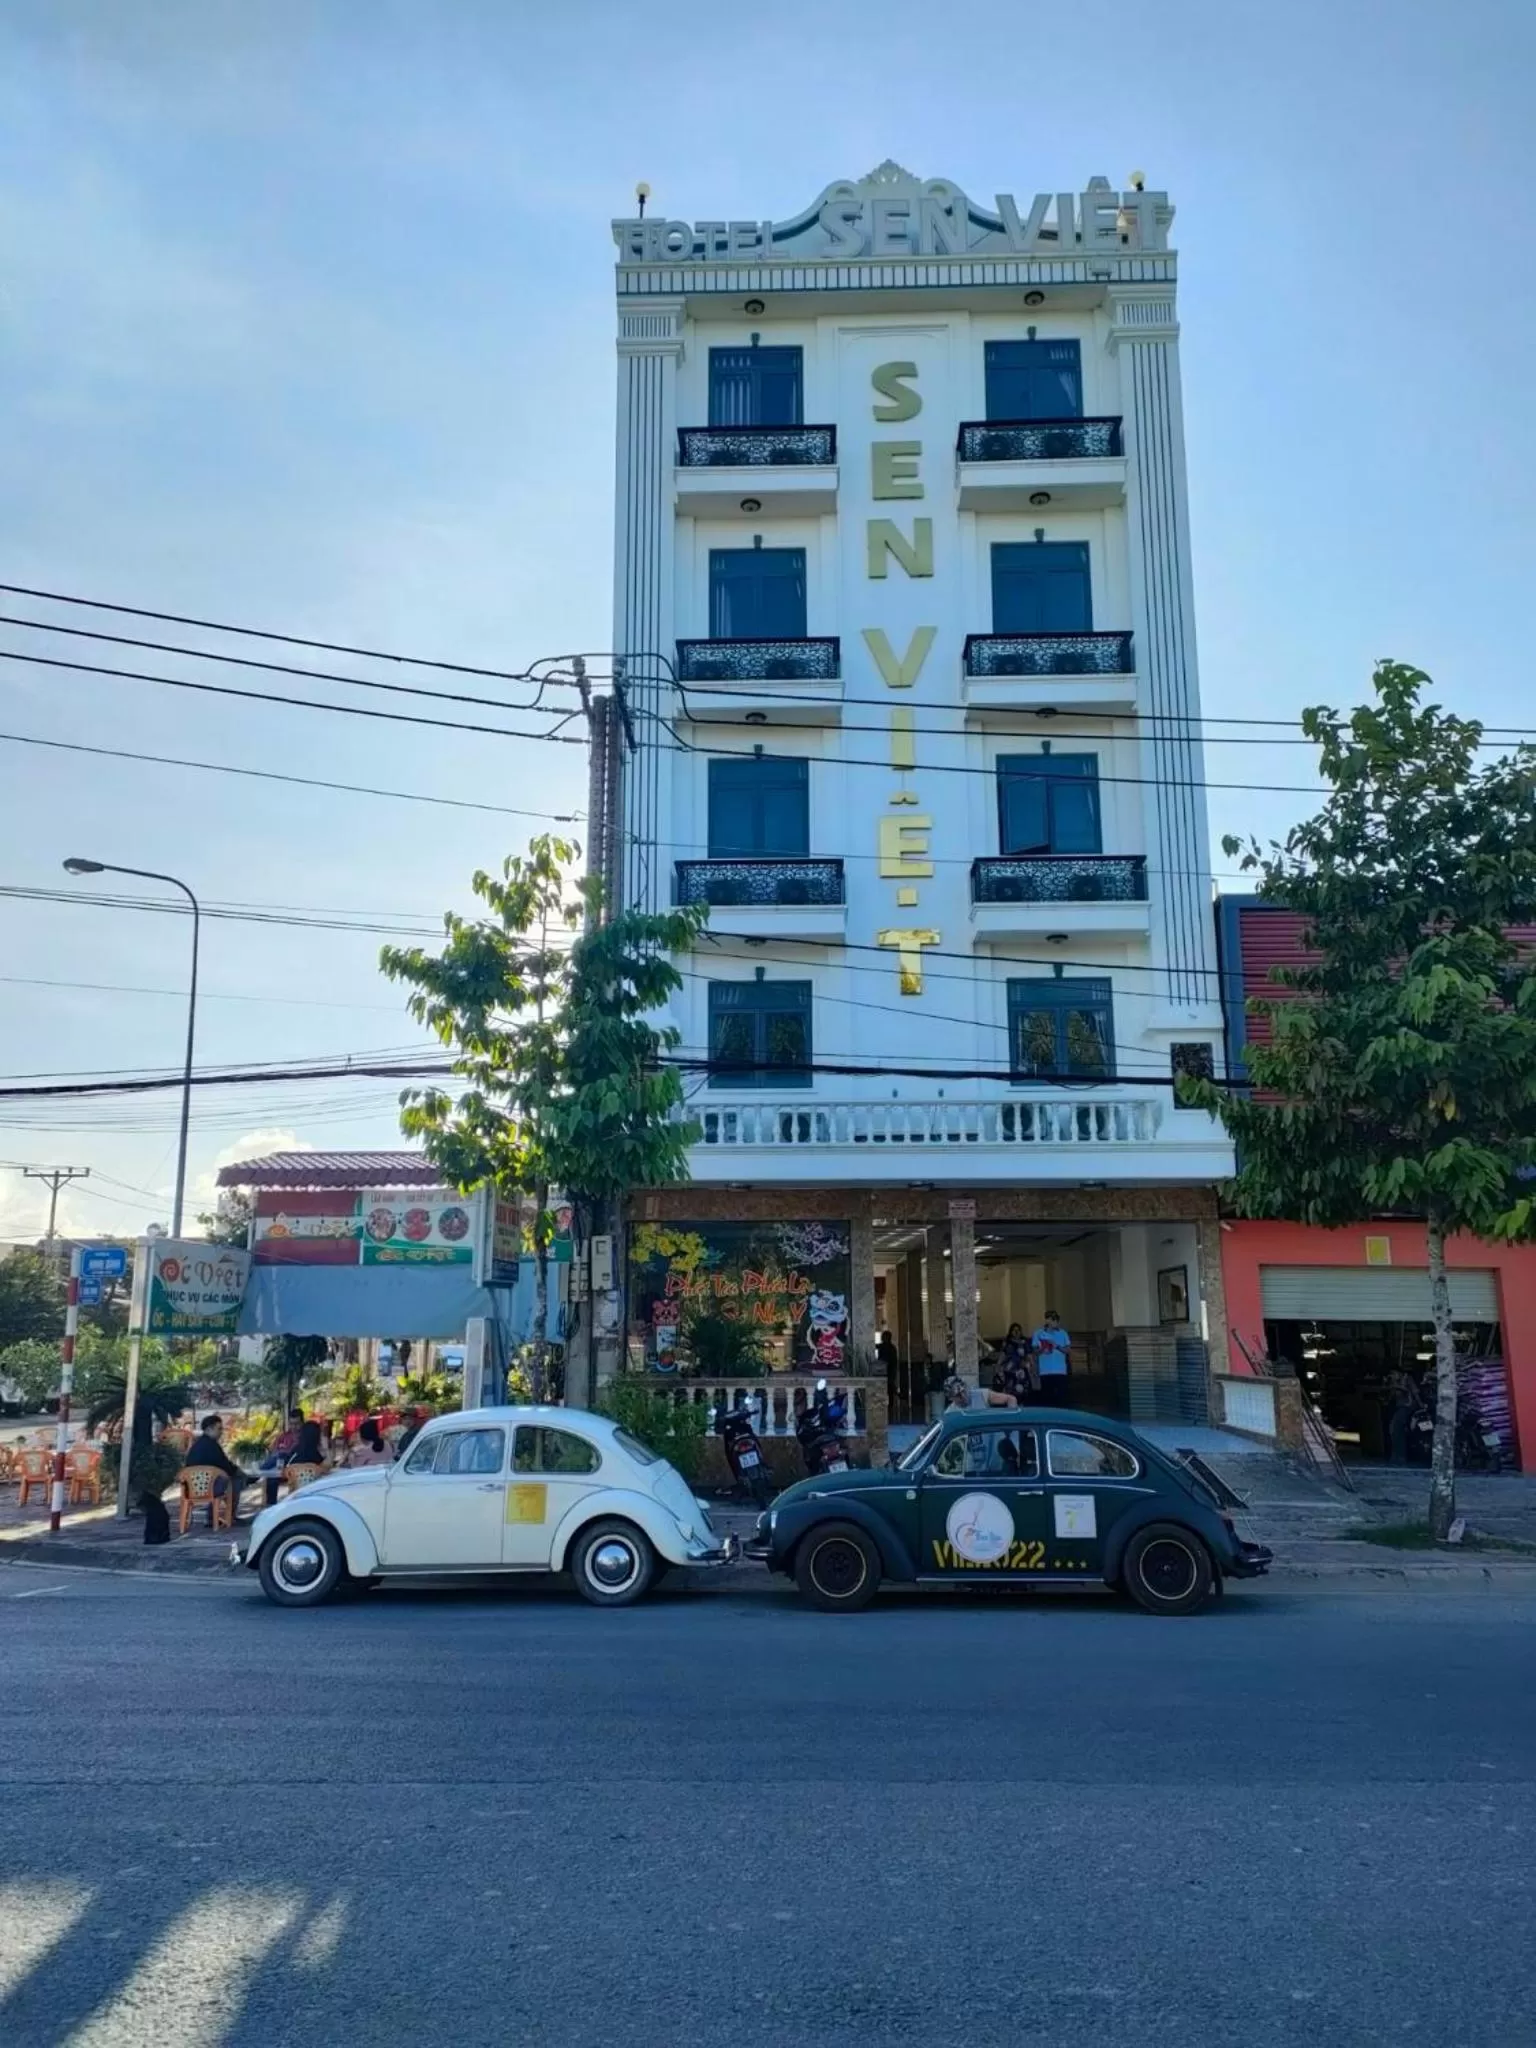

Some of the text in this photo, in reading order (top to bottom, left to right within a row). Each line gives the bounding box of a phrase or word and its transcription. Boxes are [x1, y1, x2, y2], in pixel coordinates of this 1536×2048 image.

[620, 219, 790, 262] HOTEL
[818, 197, 969, 258] SEN
[860, 360, 942, 996] SEN VIỆT
